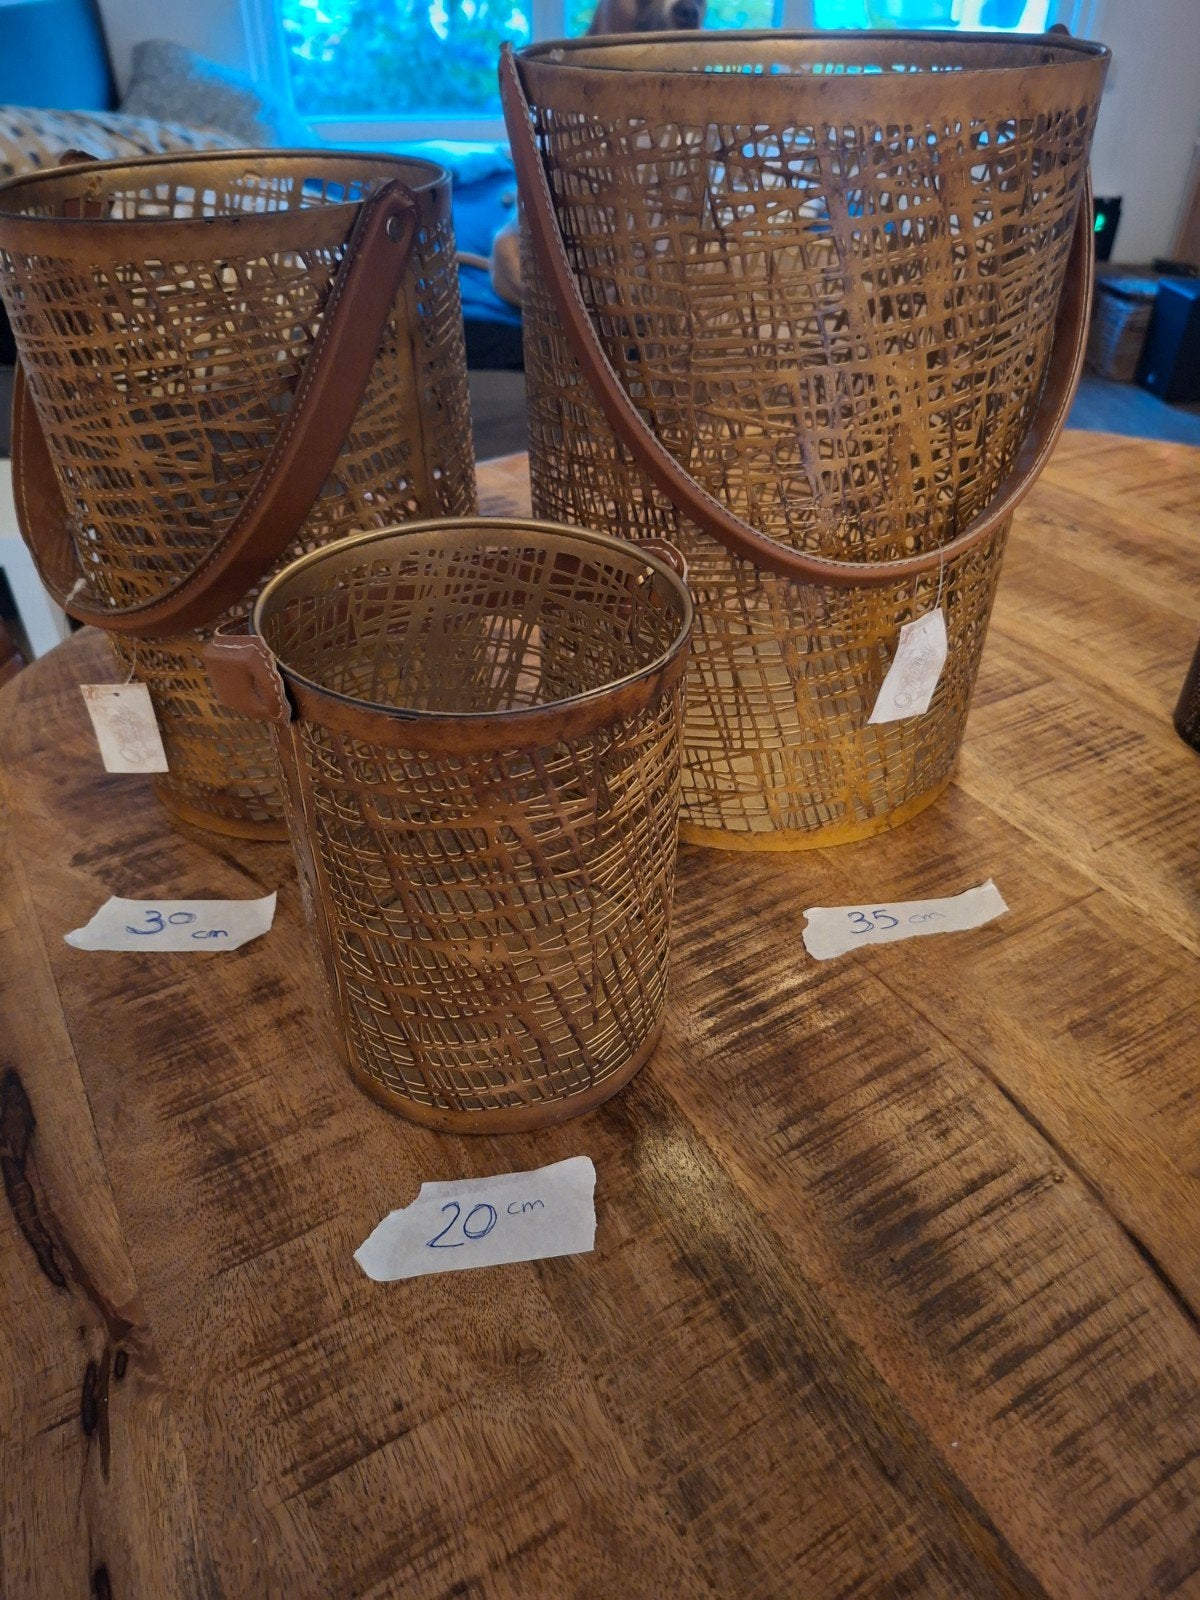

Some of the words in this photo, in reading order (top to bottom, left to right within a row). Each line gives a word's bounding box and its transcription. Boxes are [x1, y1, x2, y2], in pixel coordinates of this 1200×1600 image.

[125, 909, 197, 935] 30
[191, 929, 228, 939] cm
[847, 909, 899, 934] 35
[908, 912, 947, 924] cm
[425, 1201, 498, 1248] 20
[506, 1199, 545, 1216] cm
